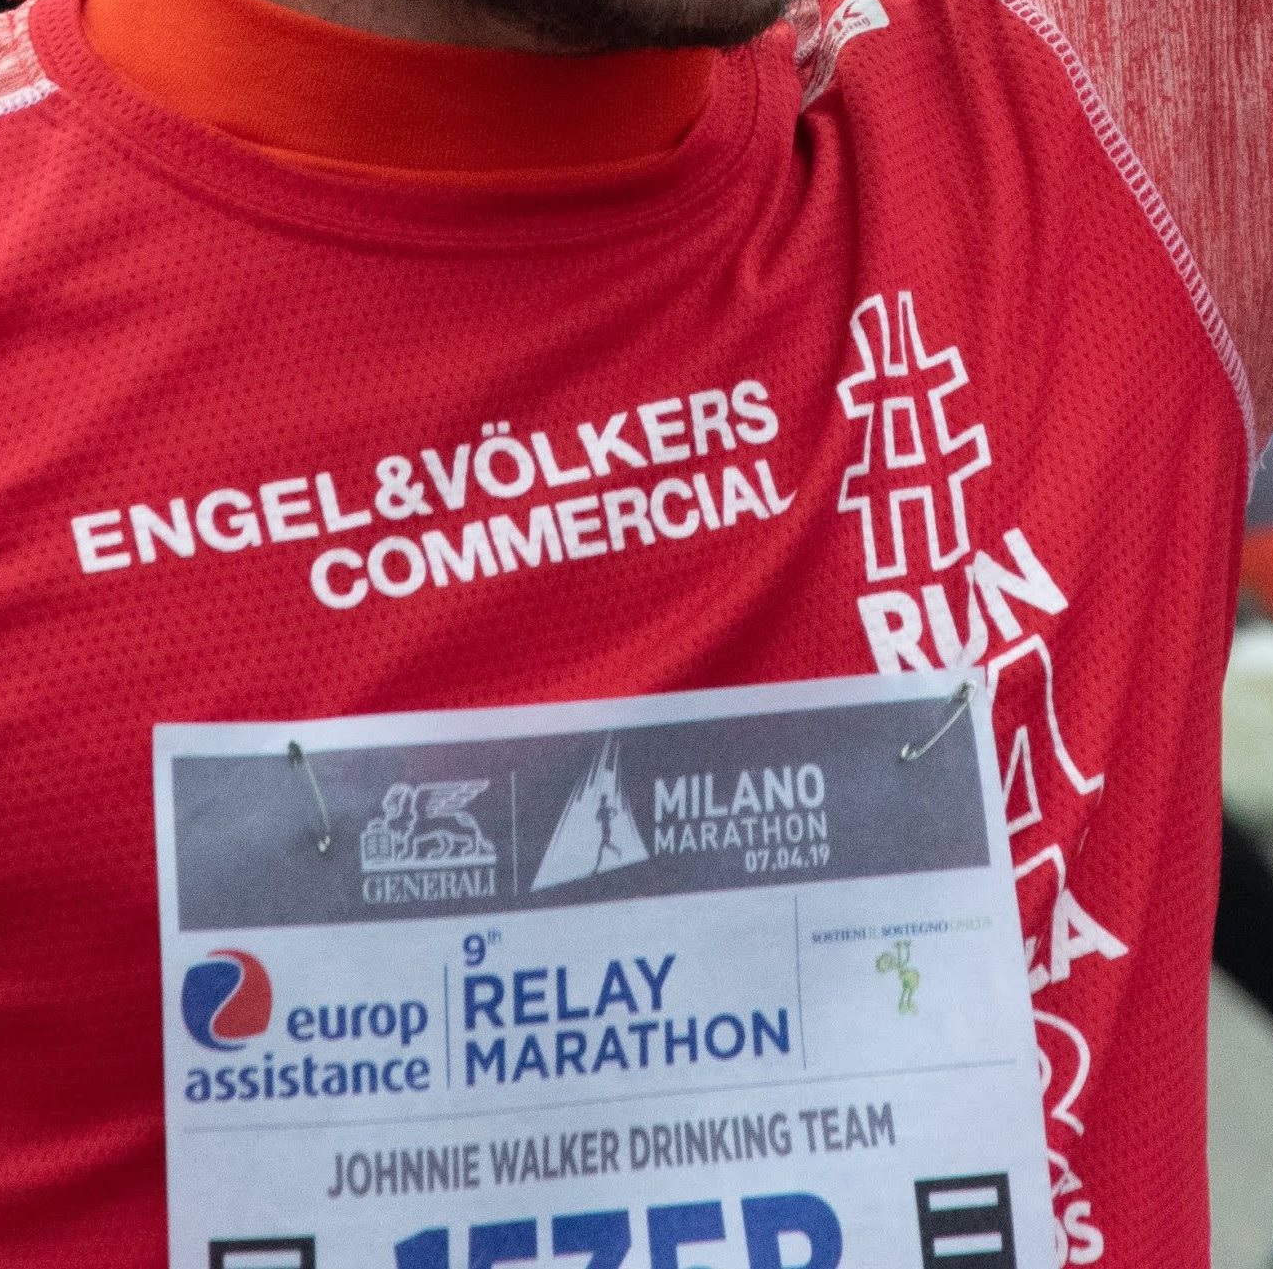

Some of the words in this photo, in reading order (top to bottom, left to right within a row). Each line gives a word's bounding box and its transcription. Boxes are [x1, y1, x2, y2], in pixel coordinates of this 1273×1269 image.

[70, 379, 779, 575] ENGEL&VÖLKERS
[309, 458, 798, 611] COMMERCIAL
[857, 527, 1069, 675] RUN
[653, 763, 826, 823] MILANO
[653, 810, 829, 856] MARATHON
[745, 842, 831, 874] 07.04.19
[361, 868, 496, 906] GENERALI
[285, 998, 430, 1047] europ
[462, 953, 676, 1031] RELAY
[184, 1050, 433, 1104] assistance
[464, 1006, 791, 1088] MARATHON
[327, 1143, 481, 1199] JOHNNIE
[490, 1130, 620, 1184] WALKER
[629, 1112, 792, 1170] DRINKING
[798, 1101, 897, 1153] TEAM
